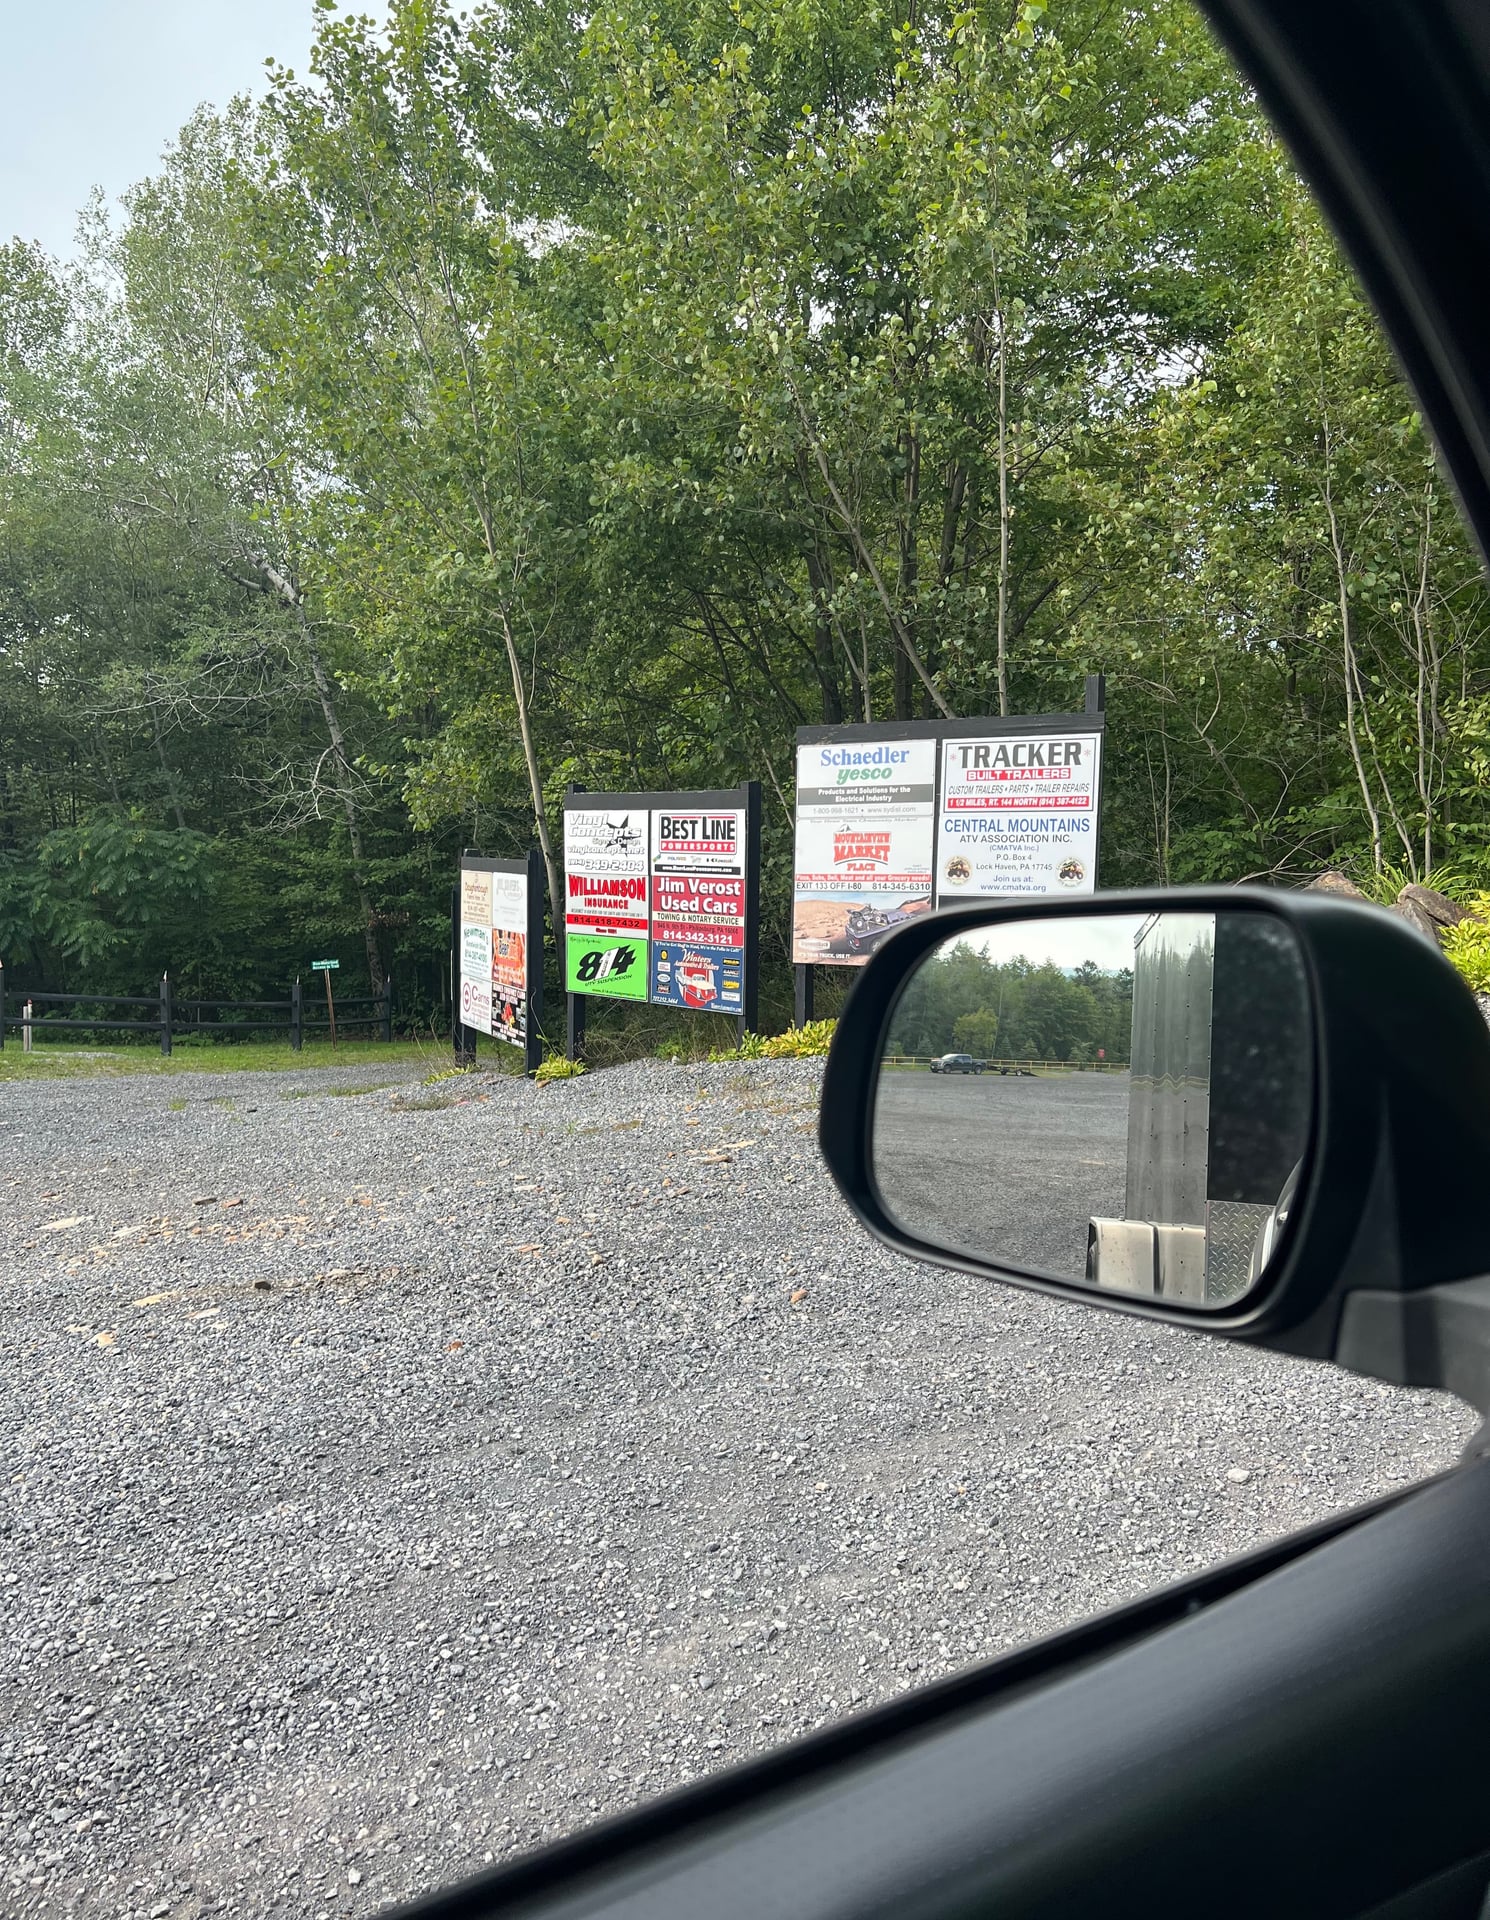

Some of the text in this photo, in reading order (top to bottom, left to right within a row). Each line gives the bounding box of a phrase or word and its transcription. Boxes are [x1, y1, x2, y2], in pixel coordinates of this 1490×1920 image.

[820, 746, 910, 766] Schaedler
[958, 742, 1082, 768] TRACKER
[836, 767, 892, 785] yesco
[967, 769, 1070, 780] BUILT TRAILERS
[948, 783, 1090, 795] CUSTOM TRAILERS PARTS TRAILER REPAIRS
[866, 795, 892, 803] Industry
[966, 798, 987, 807] MILES,
[989, 798, 999, 806] RT.
[1001, 797, 1012, 805] 144
[1014, 797, 1038, 805] NORTH
[568, 814, 609, 828] Vinyl
[944, 818, 1090, 832] CENTRAL MOUNTAINS
[568, 827, 642, 840] Concepts
[660, 816, 735, 840] BEST LINE
[960, 834, 1073, 843] ATV ASSOCIATION INC.
[661, 842, 735, 851] POWERSPORTS
[834, 845, 890, 862] MARKET
[847, 863, 876, 872] PLACE
[568, 874, 646, 902] WILLIAMSON
[657, 877, 741, 896] Jim Verost
[796, 882, 813, 890] EXIT
[830, 882, 846, 890] OFF
[847, 882, 862, 890] I-80
[584, 898, 628, 909] INSURANCE
[661, 895, 738, 914] Used Cars
[574, 917, 640, 927] 814-418-7432
[657, 913, 680, 921] TOWING
[713, 917, 739, 925] SERVICE
[663, 930, 732, 944] 814-342-3121
[576, 944, 637, 982] 814
